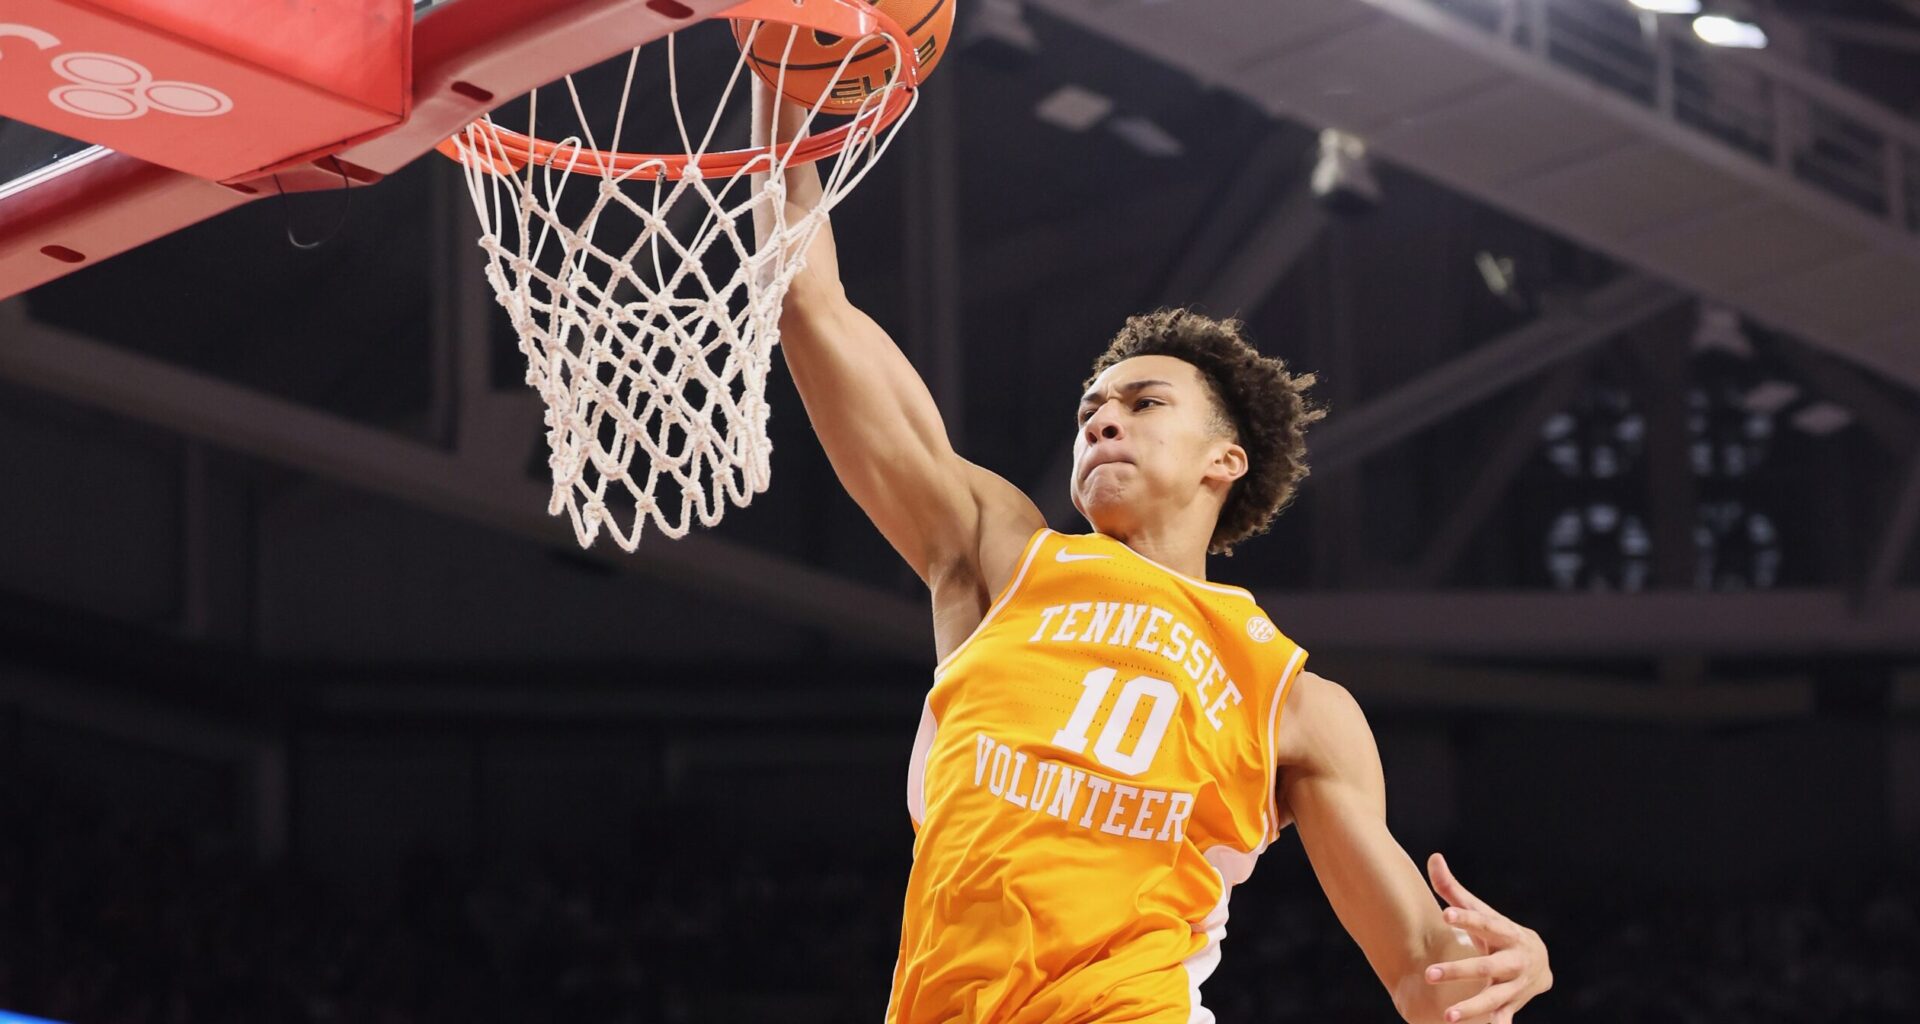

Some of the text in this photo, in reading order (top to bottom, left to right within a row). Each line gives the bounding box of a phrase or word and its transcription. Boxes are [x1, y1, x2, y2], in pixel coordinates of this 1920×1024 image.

[1029, 602, 1242, 731] TENNESSEE
[1248, 617, 1275, 641] SEC
[1052, 667, 1179, 776] 10
